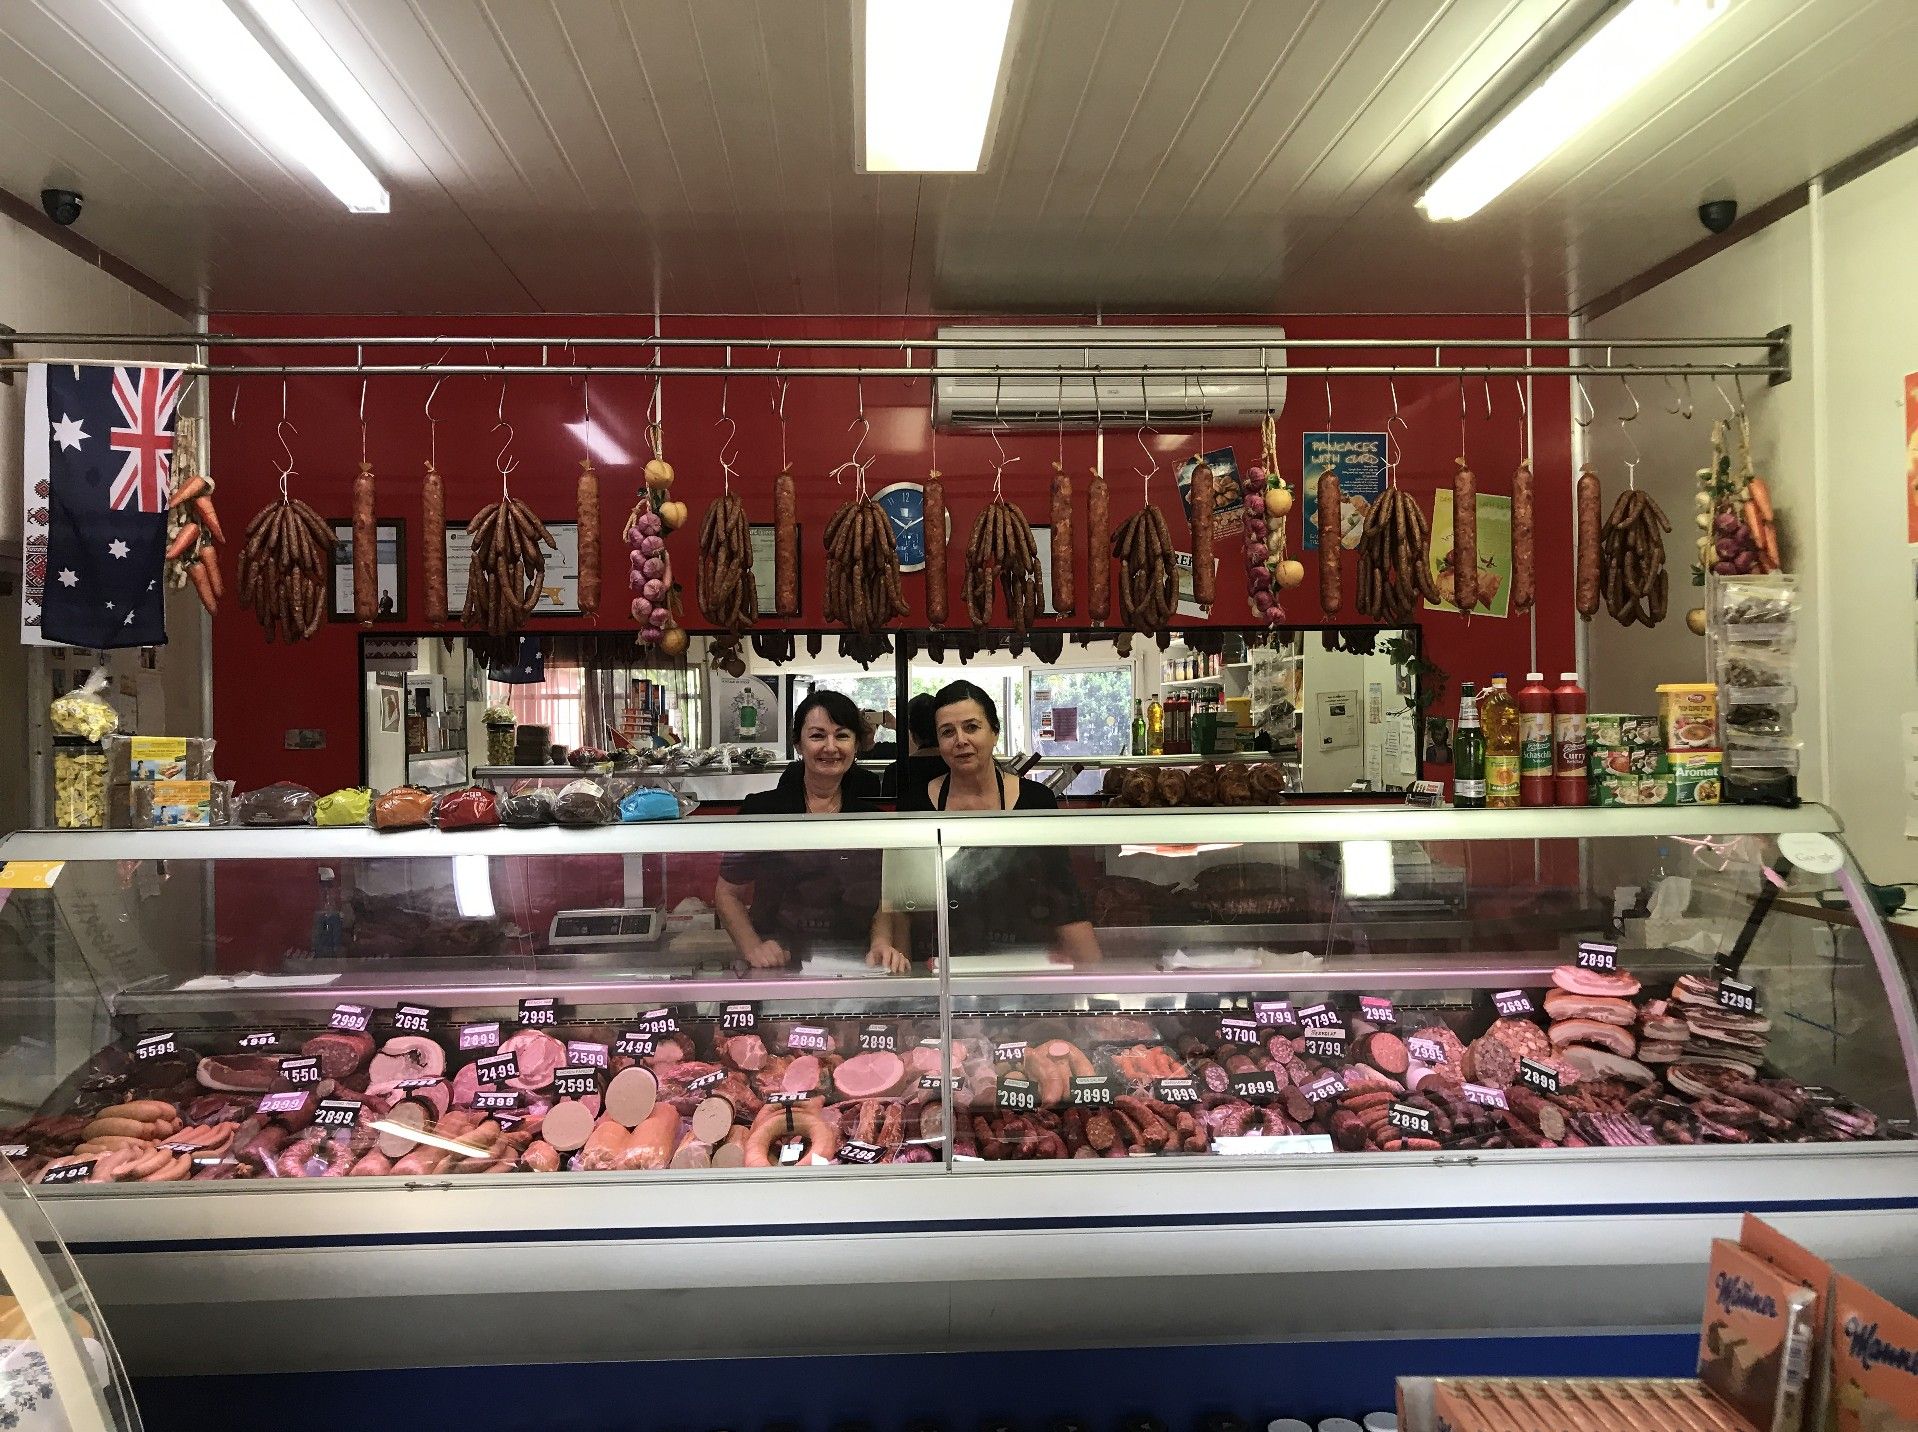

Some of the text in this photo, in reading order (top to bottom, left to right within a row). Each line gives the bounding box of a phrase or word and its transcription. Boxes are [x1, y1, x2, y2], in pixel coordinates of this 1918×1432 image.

[902, 492, 910, 503] 12
[1563, 752, 1586, 762] Curry
[1675, 767, 1720, 777] Aromat
[1720, 990, 1753, 1010] 3299
